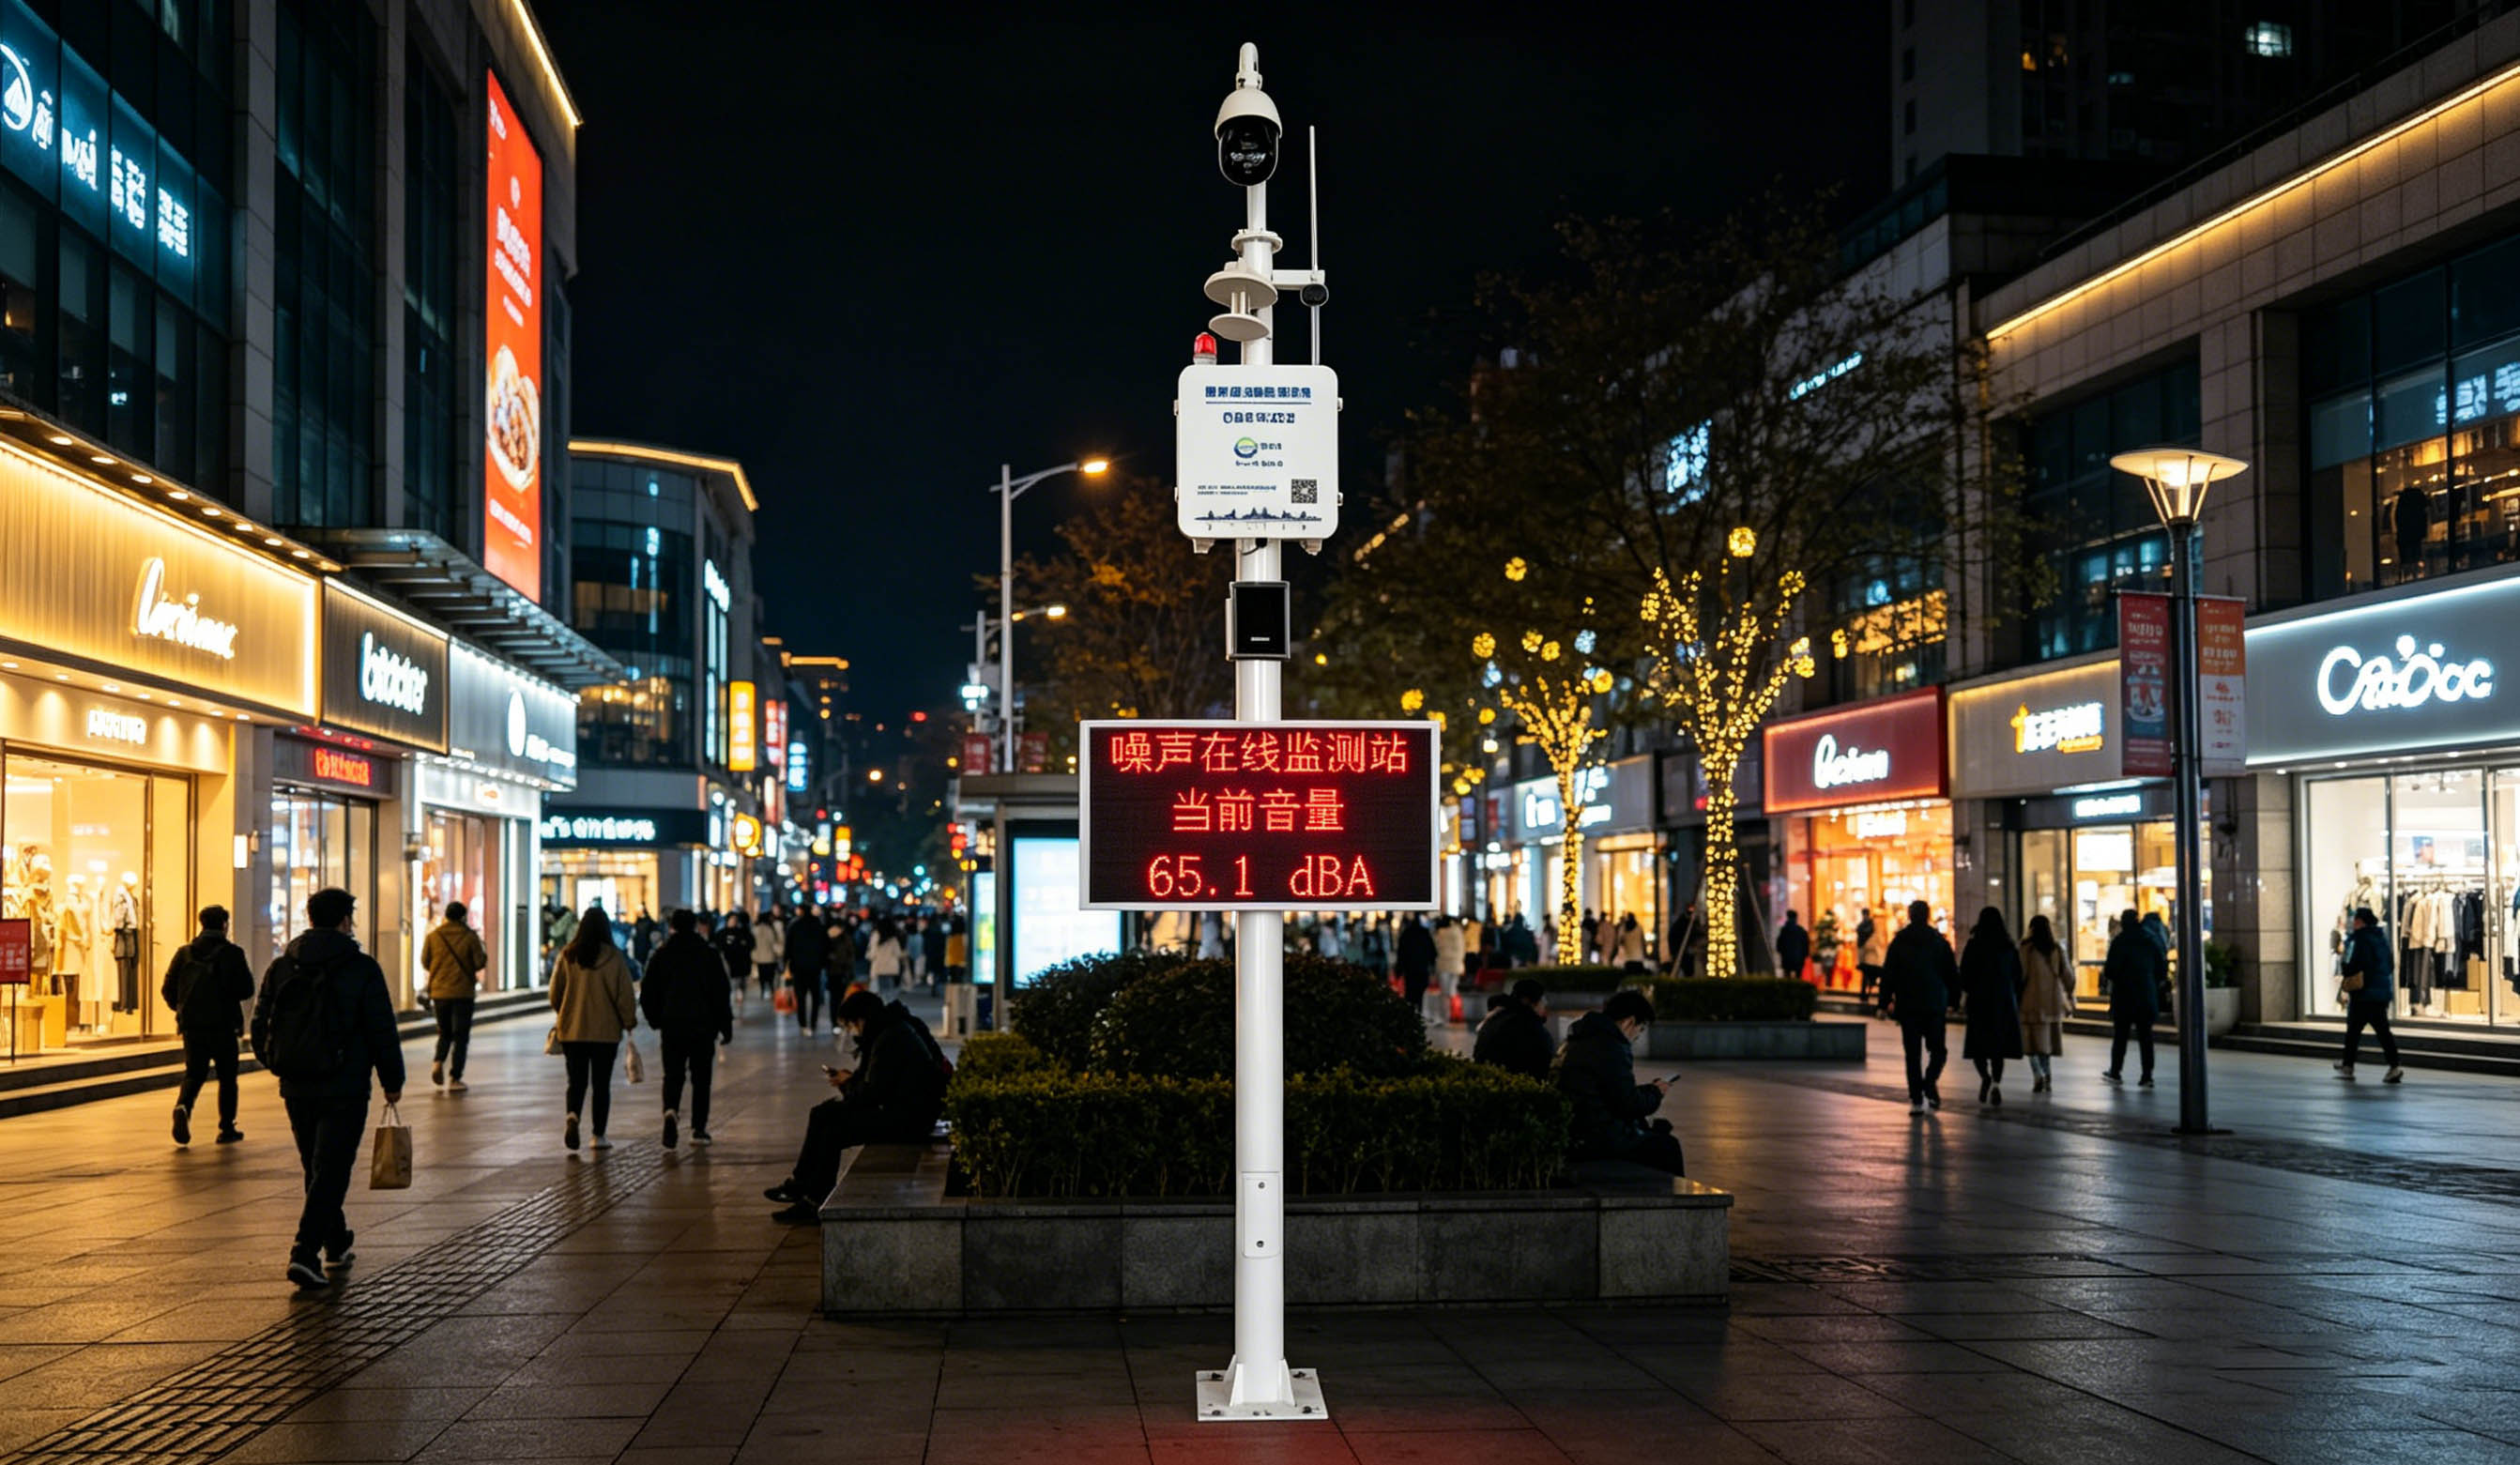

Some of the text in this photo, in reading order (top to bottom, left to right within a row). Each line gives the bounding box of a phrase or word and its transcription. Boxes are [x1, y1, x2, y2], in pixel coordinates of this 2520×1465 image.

[1110, 732, 1408, 774] 噪声在线监测站
[1172, 787, 1344, 832] 当前音量
[1148, 855, 1374, 897] 65.1 dBA
